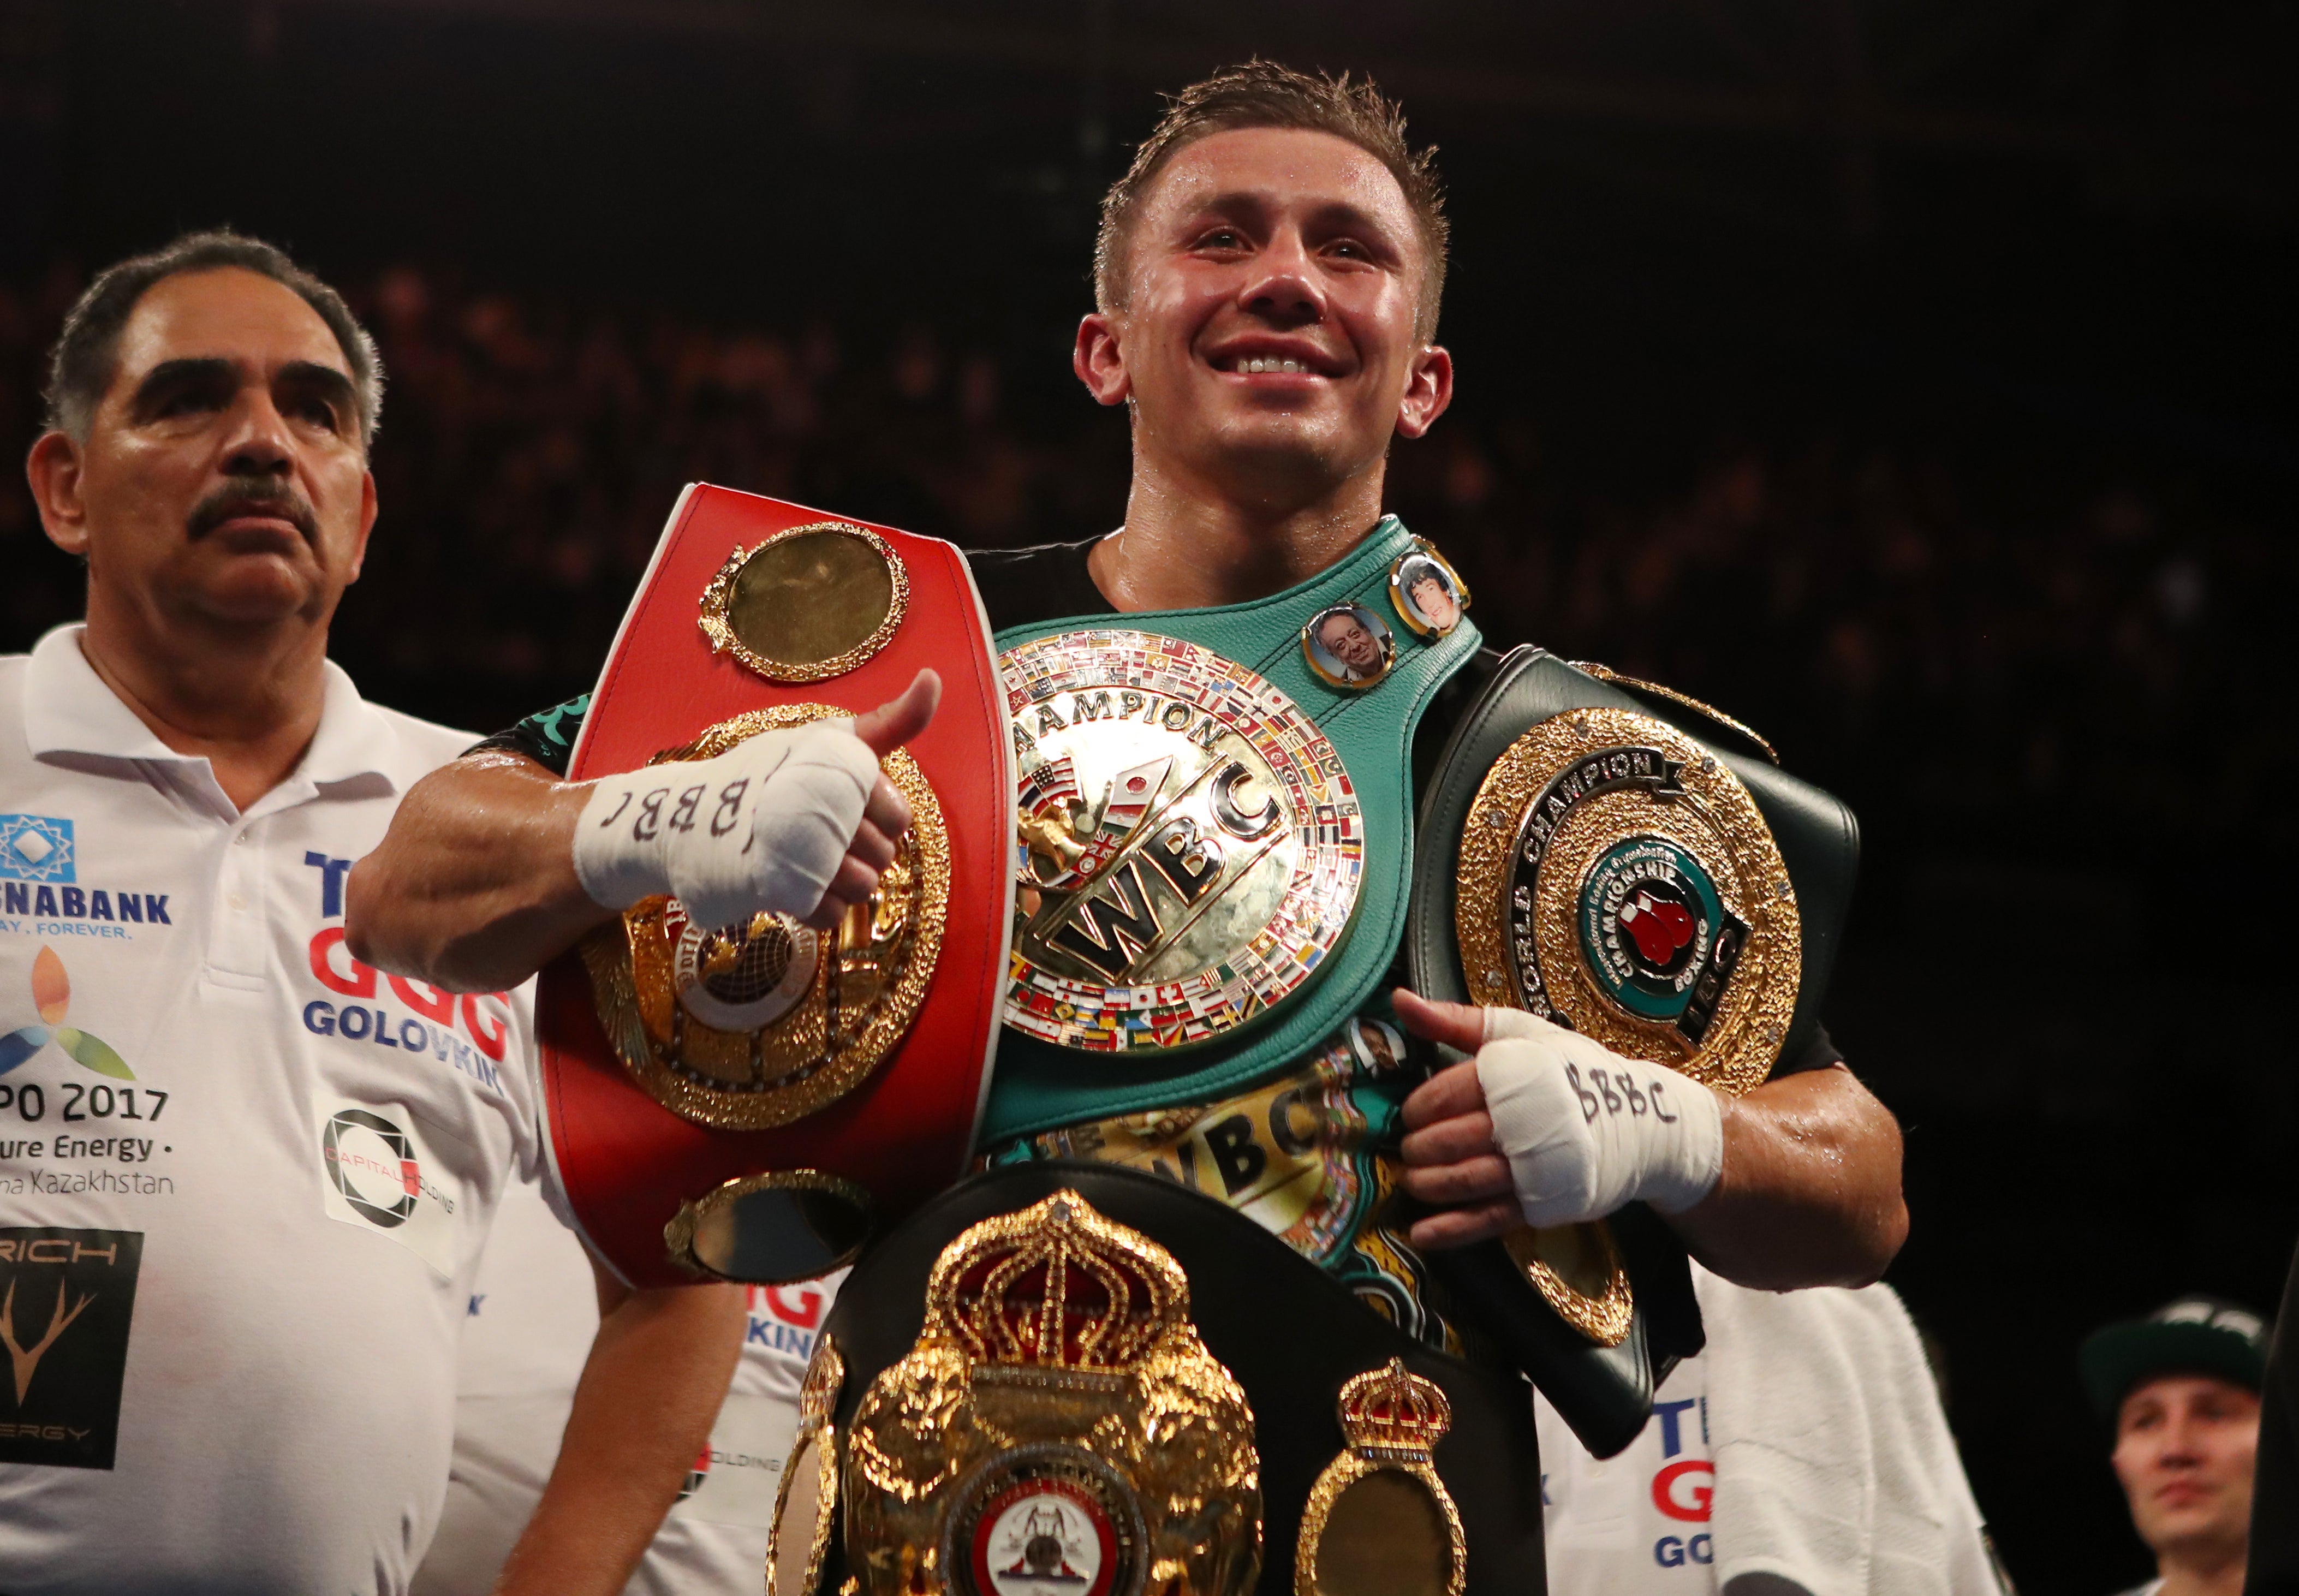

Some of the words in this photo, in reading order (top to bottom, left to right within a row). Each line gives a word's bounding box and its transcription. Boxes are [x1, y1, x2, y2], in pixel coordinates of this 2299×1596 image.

[1012, 690, 1232, 755] HAMPION
[1523, 752, 1653, 864] CHAMPION
[1045, 761, 1288, 984] WBC
[0, 882, 172, 926] NABANK
[37, 922, 133, 940] FOREVER.
[665, 898, 687, 927] IB
[1603, 860, 1677, 978] CHAMPIONSHIP
[1514, 885, 1551, 1020] WORLD
[1675, 918, 1709, 993] BOXING
[303, 1000, 505, 1097] GOLOVKIN
[62, 1083, 169, 1122] 2017
[1565, 1063, 1678, 1123] BBBC
[54, 1135, 154, 1163] Energy
[31, 1169, 174, 1195] Kazakhstan
[747, 1316, 812, 1360] KIN
